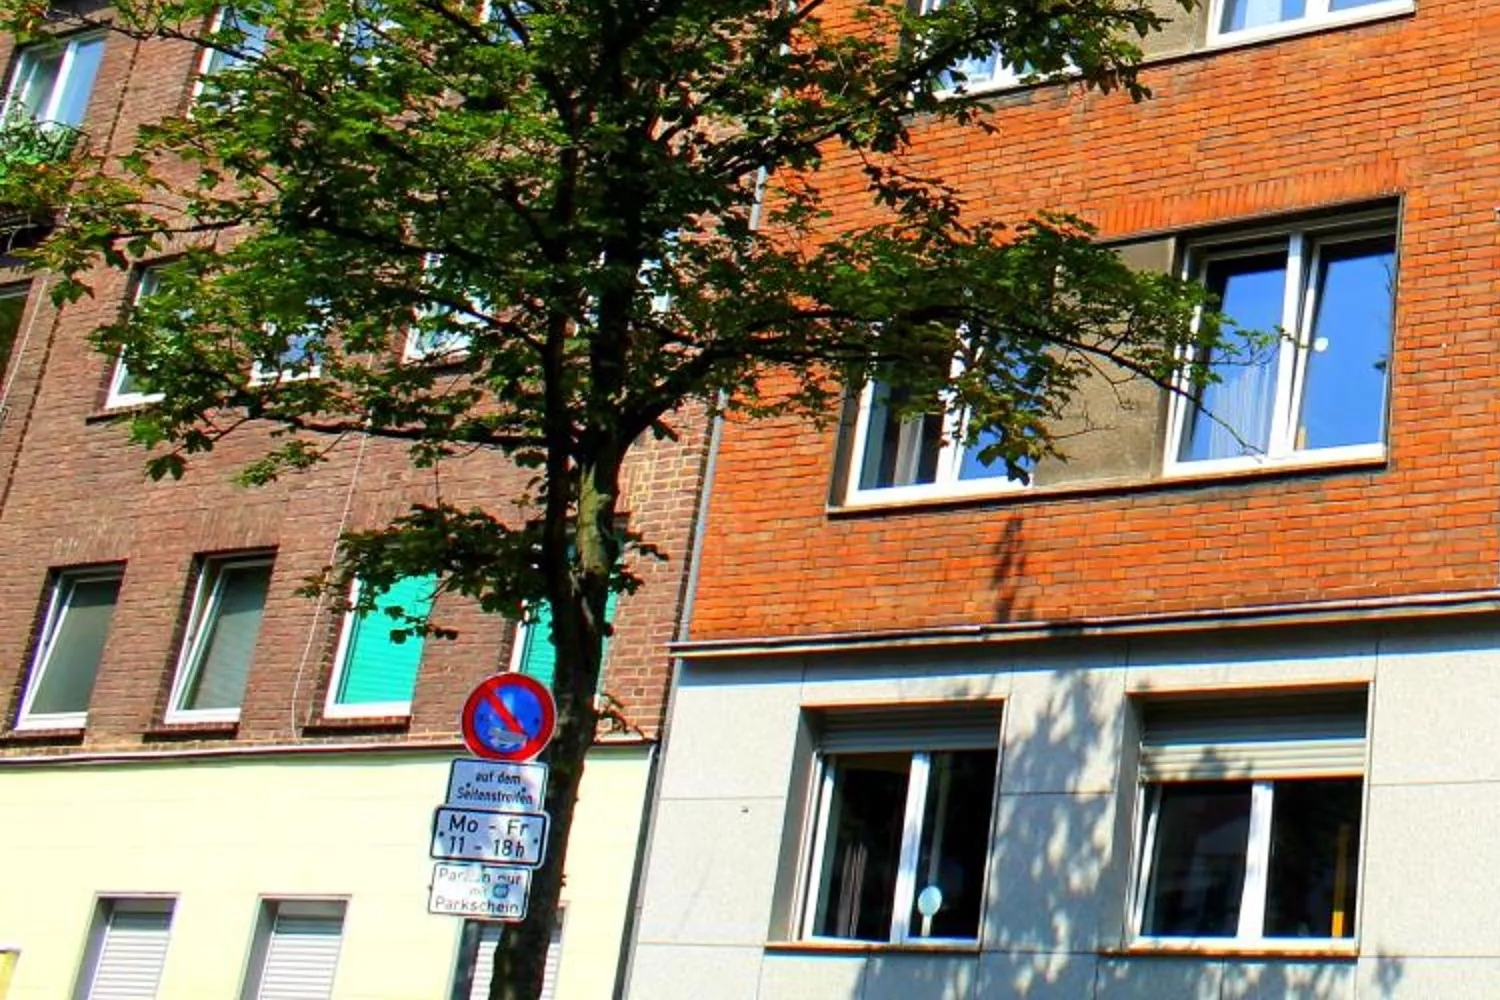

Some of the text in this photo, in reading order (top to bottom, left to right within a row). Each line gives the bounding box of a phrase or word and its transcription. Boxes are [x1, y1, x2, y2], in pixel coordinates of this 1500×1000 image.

[475, 771, 521, 785] auf dem
[457, 787, 533, 804] Seitenstreifen
[449, 814, 479, 833] Mo
[507, 820, 530, 836] Fr
[449, 835, 465, 854] 11
[439, 867, 491, 883] Parn
[435, 896, 519, 913] Parkschein
